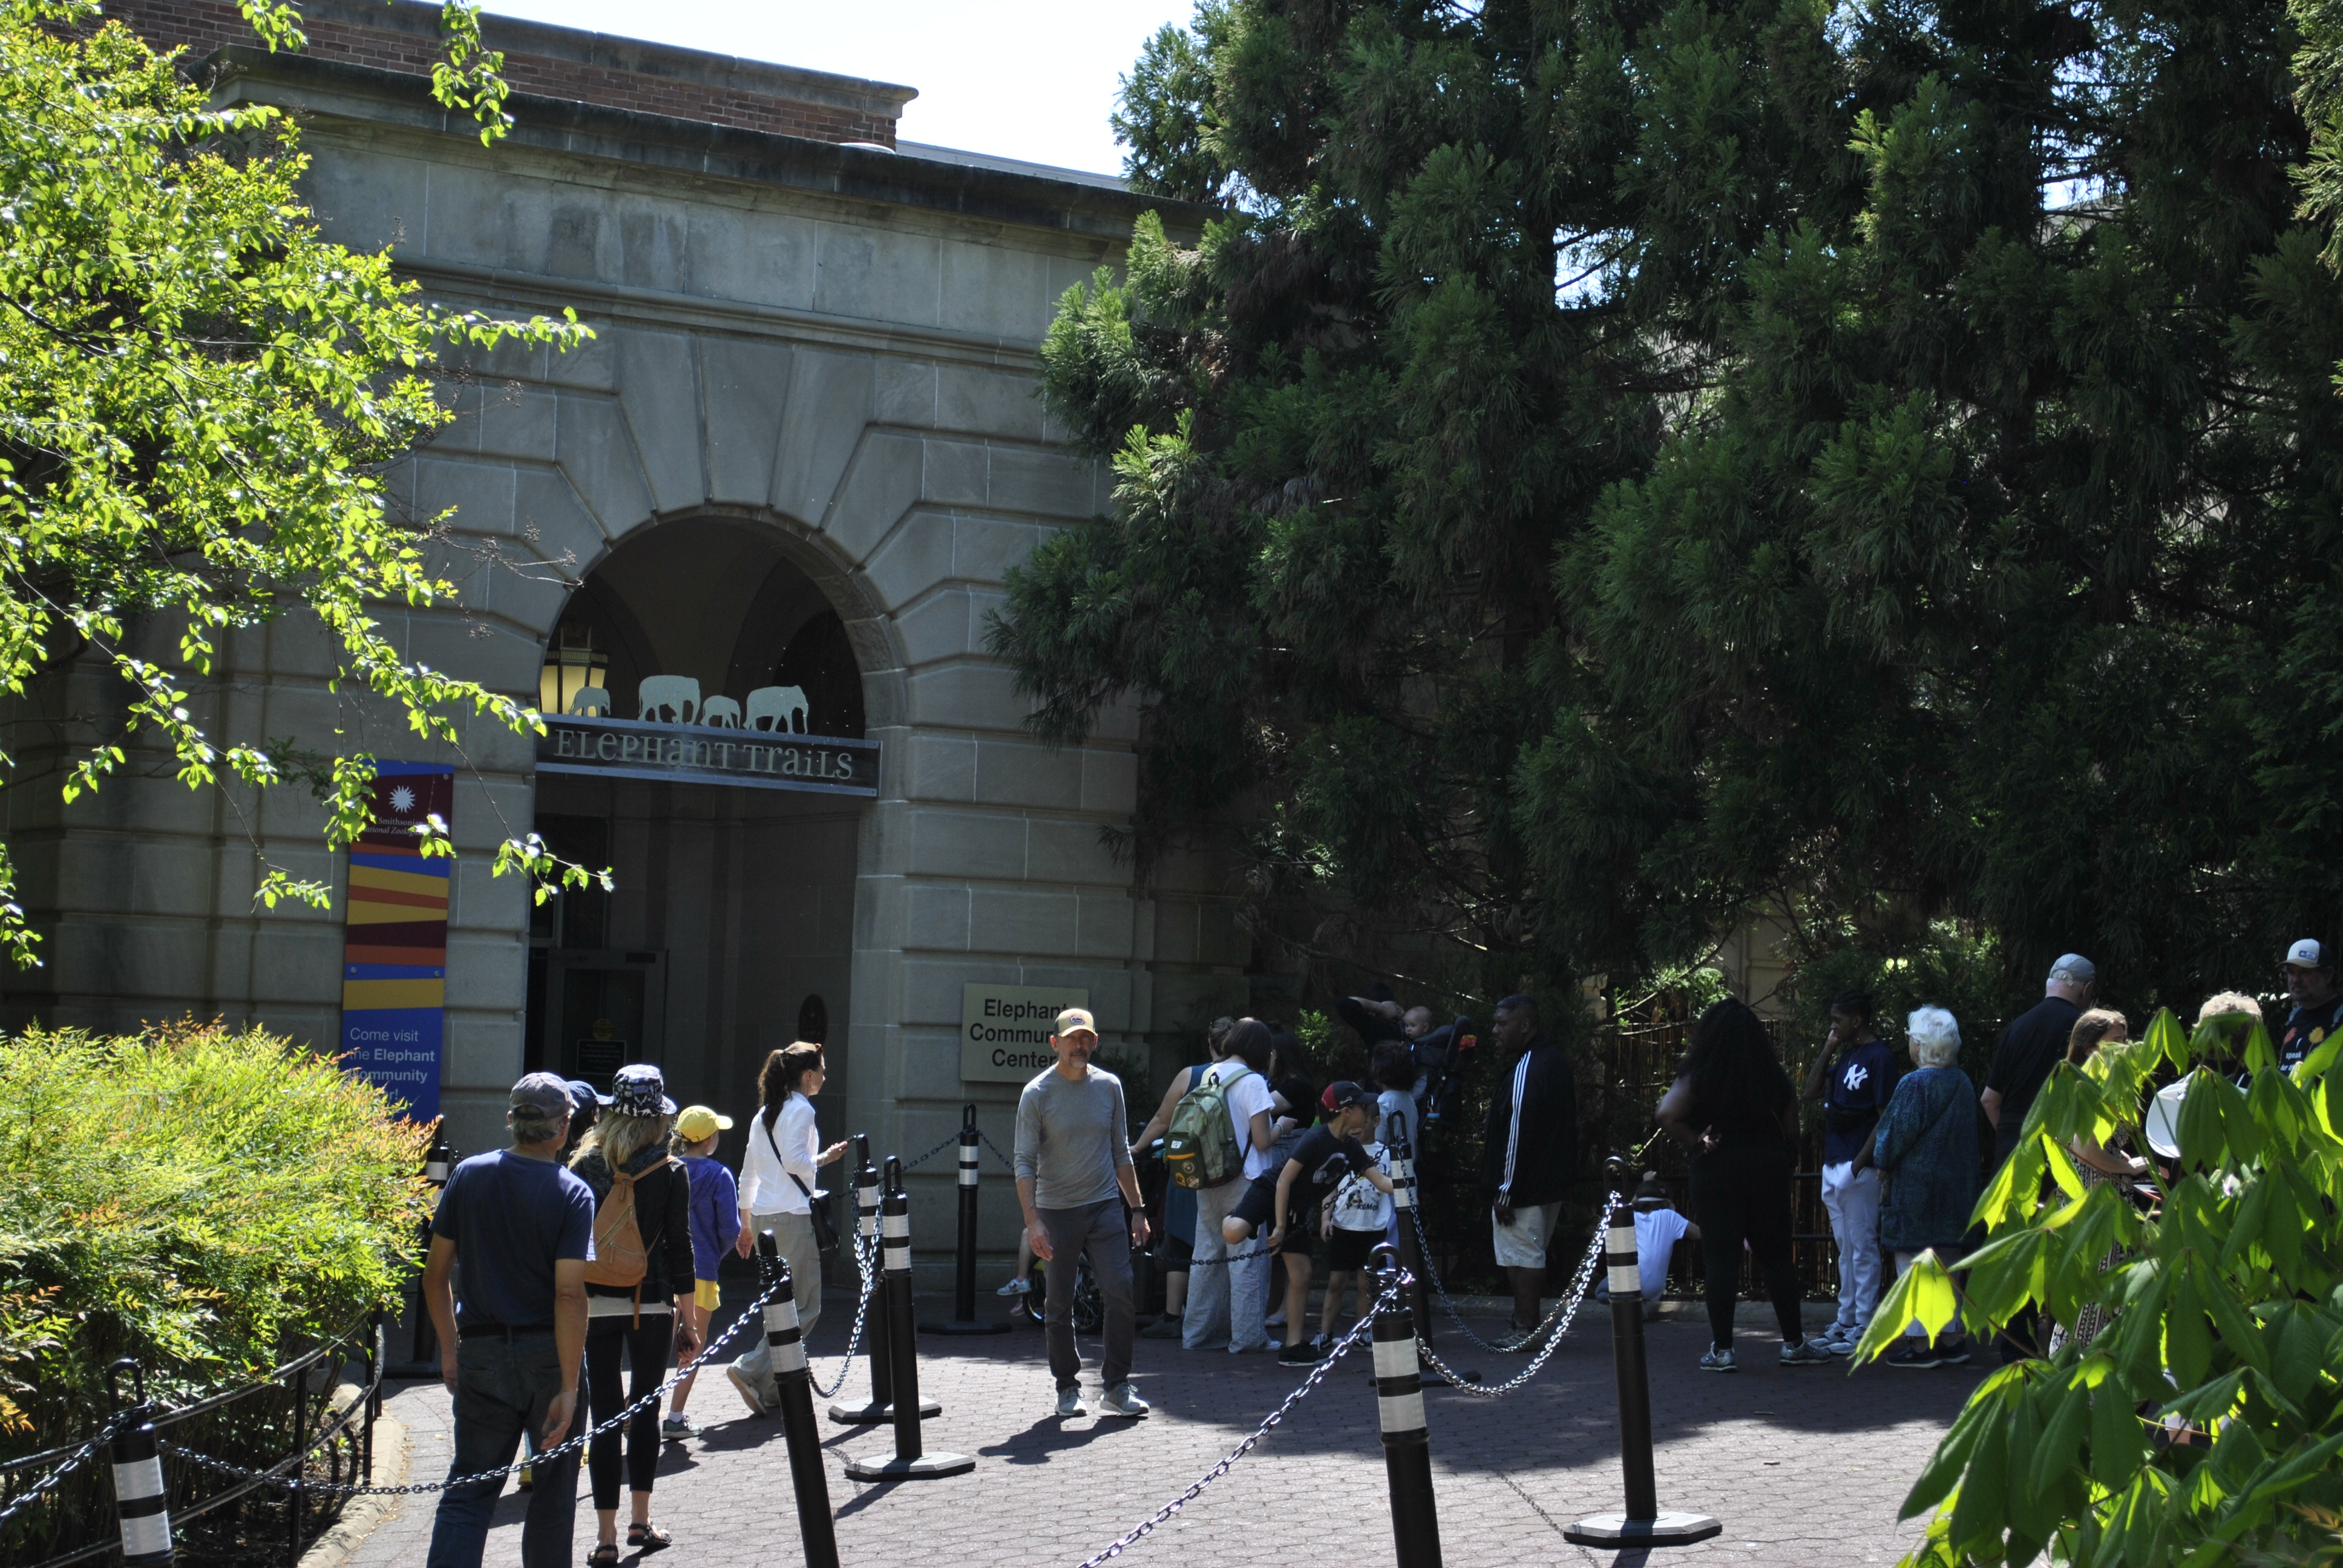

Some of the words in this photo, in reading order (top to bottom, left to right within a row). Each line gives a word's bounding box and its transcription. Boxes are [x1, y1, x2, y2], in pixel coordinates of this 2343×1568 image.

[350, 1027, 389, 1041] Come
[393, 1030, 419, 1042] visit
[350, 1048, 370, 1060] the
[374, 1048, 435, 1063] Elephant
[992, 1048, 1057, 1068] Center
[2286, 1051, 2302, 1060] speak
[359, 1069, 428, 1084] ommunity
[1843, 1063, 1868, 1091] NY
